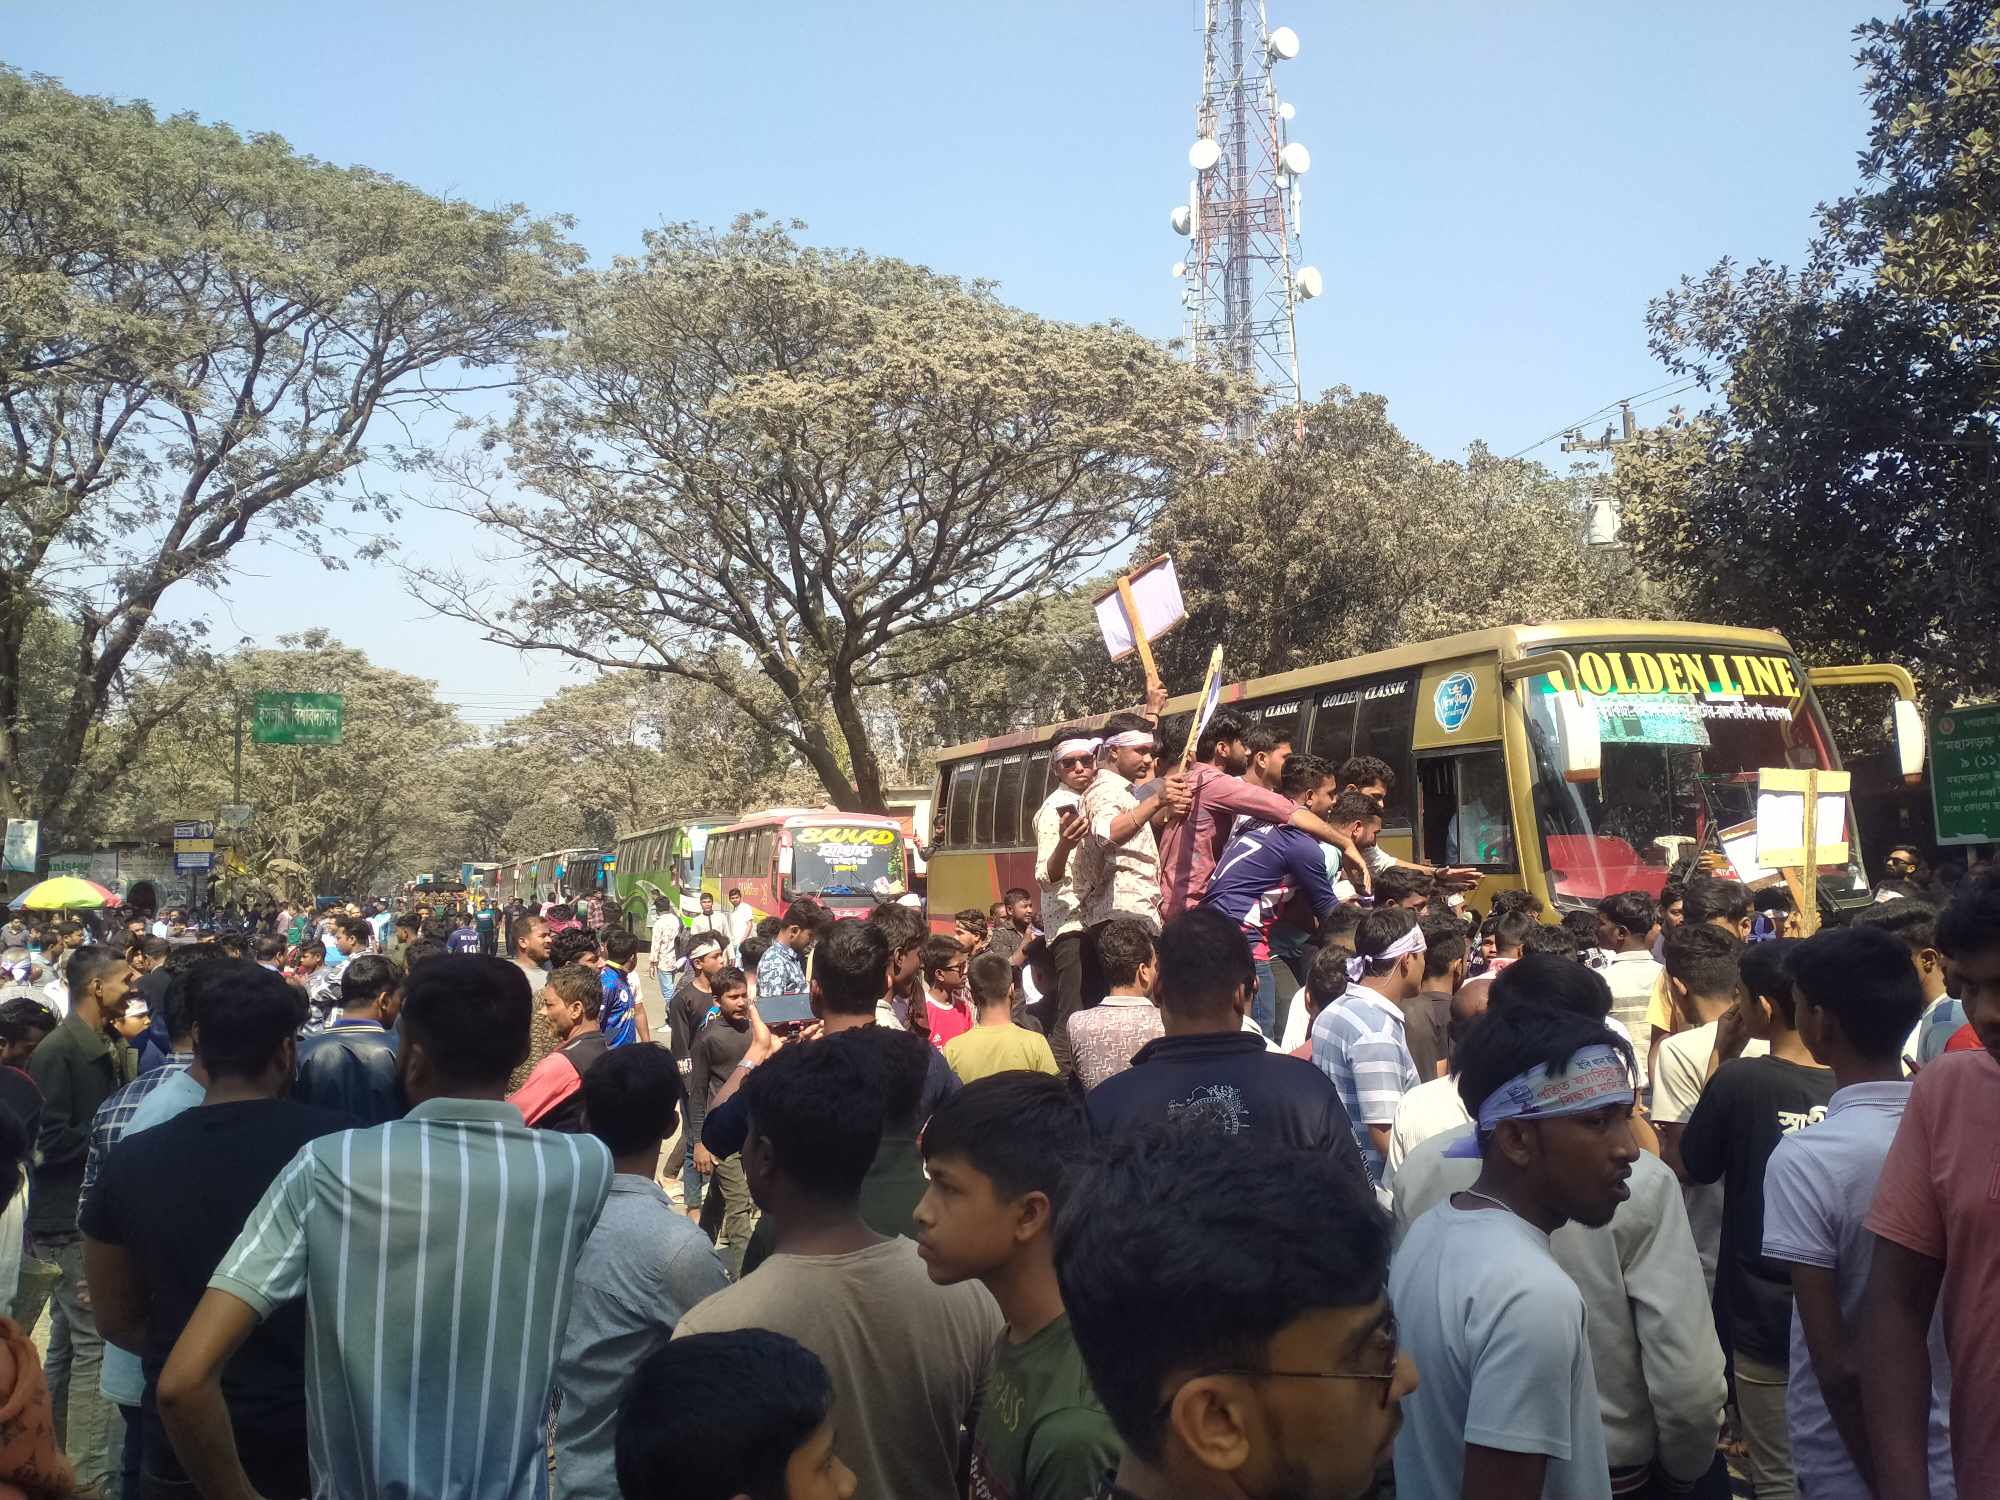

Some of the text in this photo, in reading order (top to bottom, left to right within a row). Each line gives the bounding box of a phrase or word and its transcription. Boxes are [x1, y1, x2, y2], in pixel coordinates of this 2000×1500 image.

[1709, 654, 1800, 698] LINE
[1322, 680, 1409, 709] GOLDEN CLASSIC
[1265, 701, 1301, 718] CLASSIC
